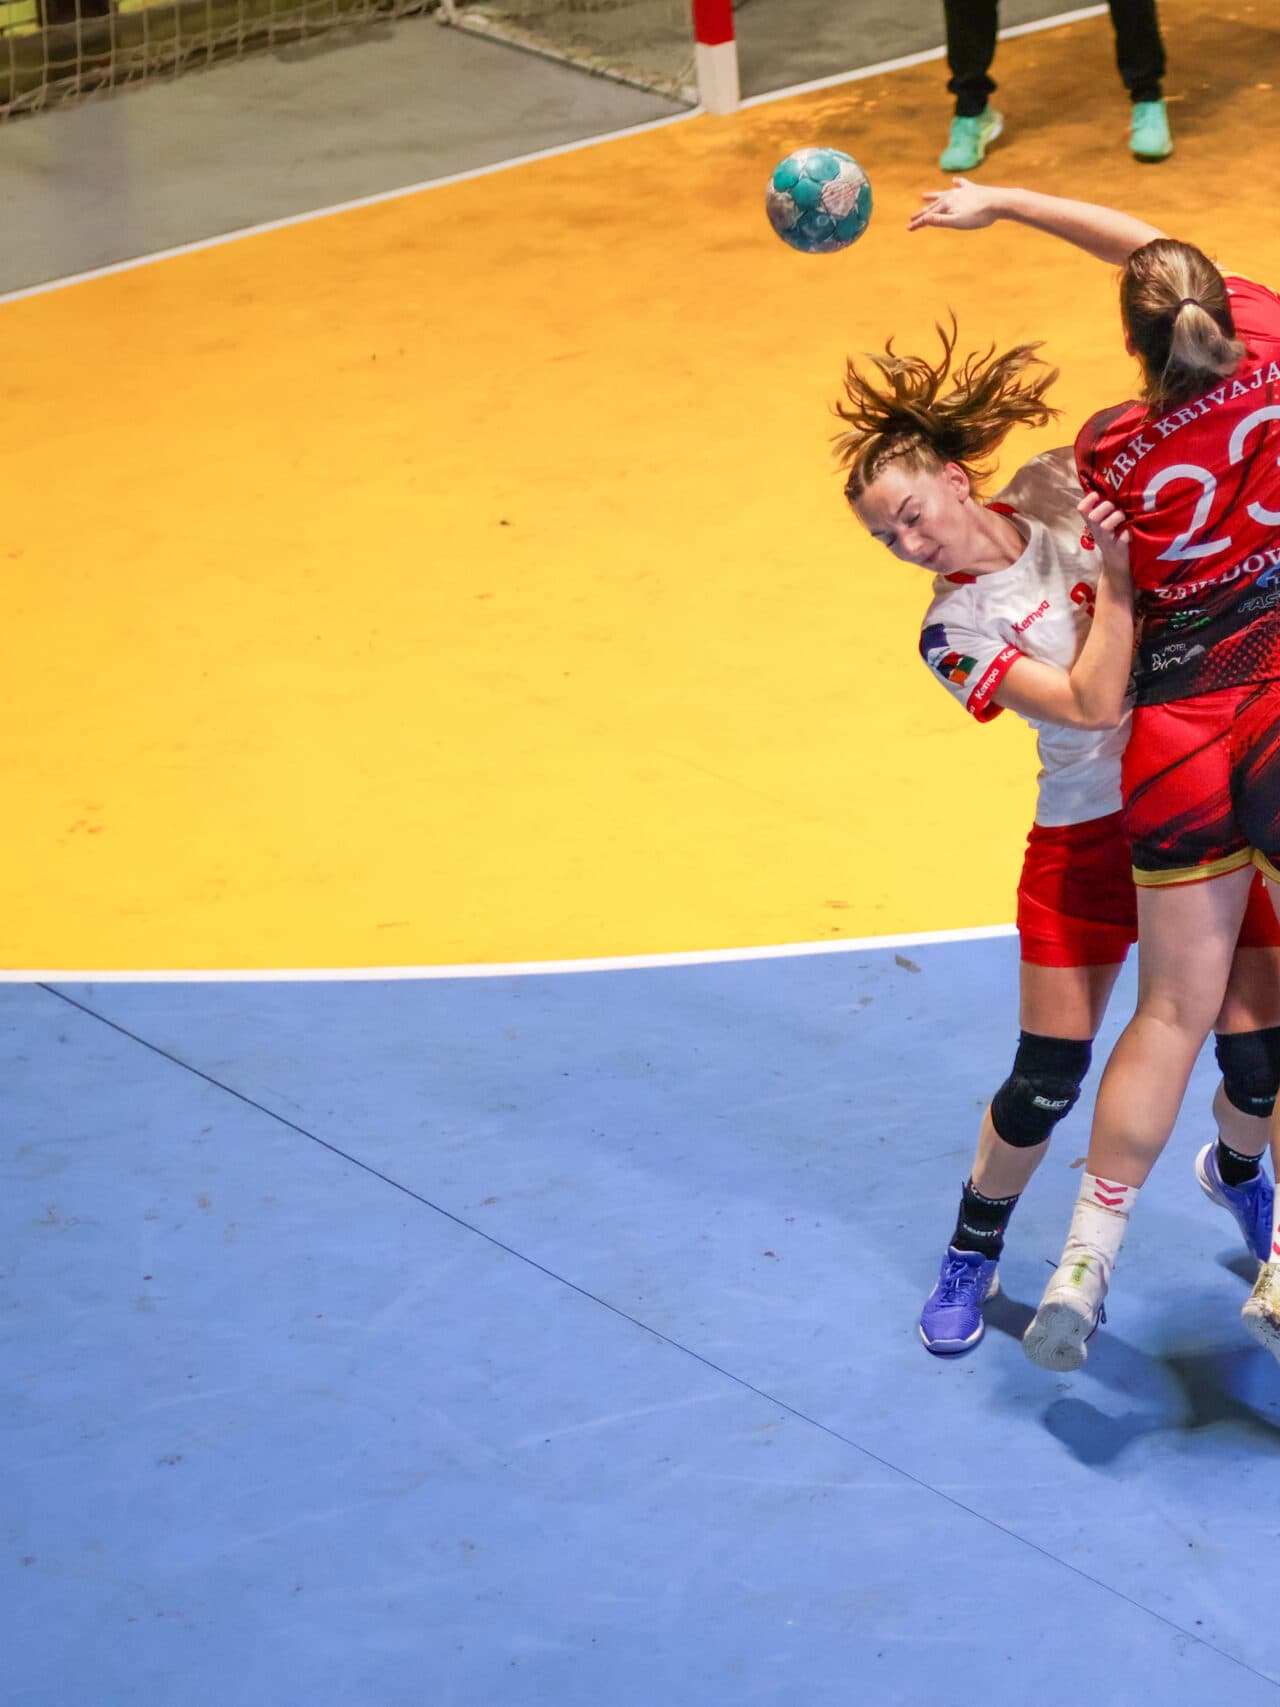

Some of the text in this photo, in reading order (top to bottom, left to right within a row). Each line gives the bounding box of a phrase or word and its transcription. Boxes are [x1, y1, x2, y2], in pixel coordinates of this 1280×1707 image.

[1103, 433, 1156, 491] ŽRK
[1012, 599, 1051, 634] Kempa
[975, 668, 1000, 700] Kempa
[1033, 1096, 1070, 1110] SELECT
